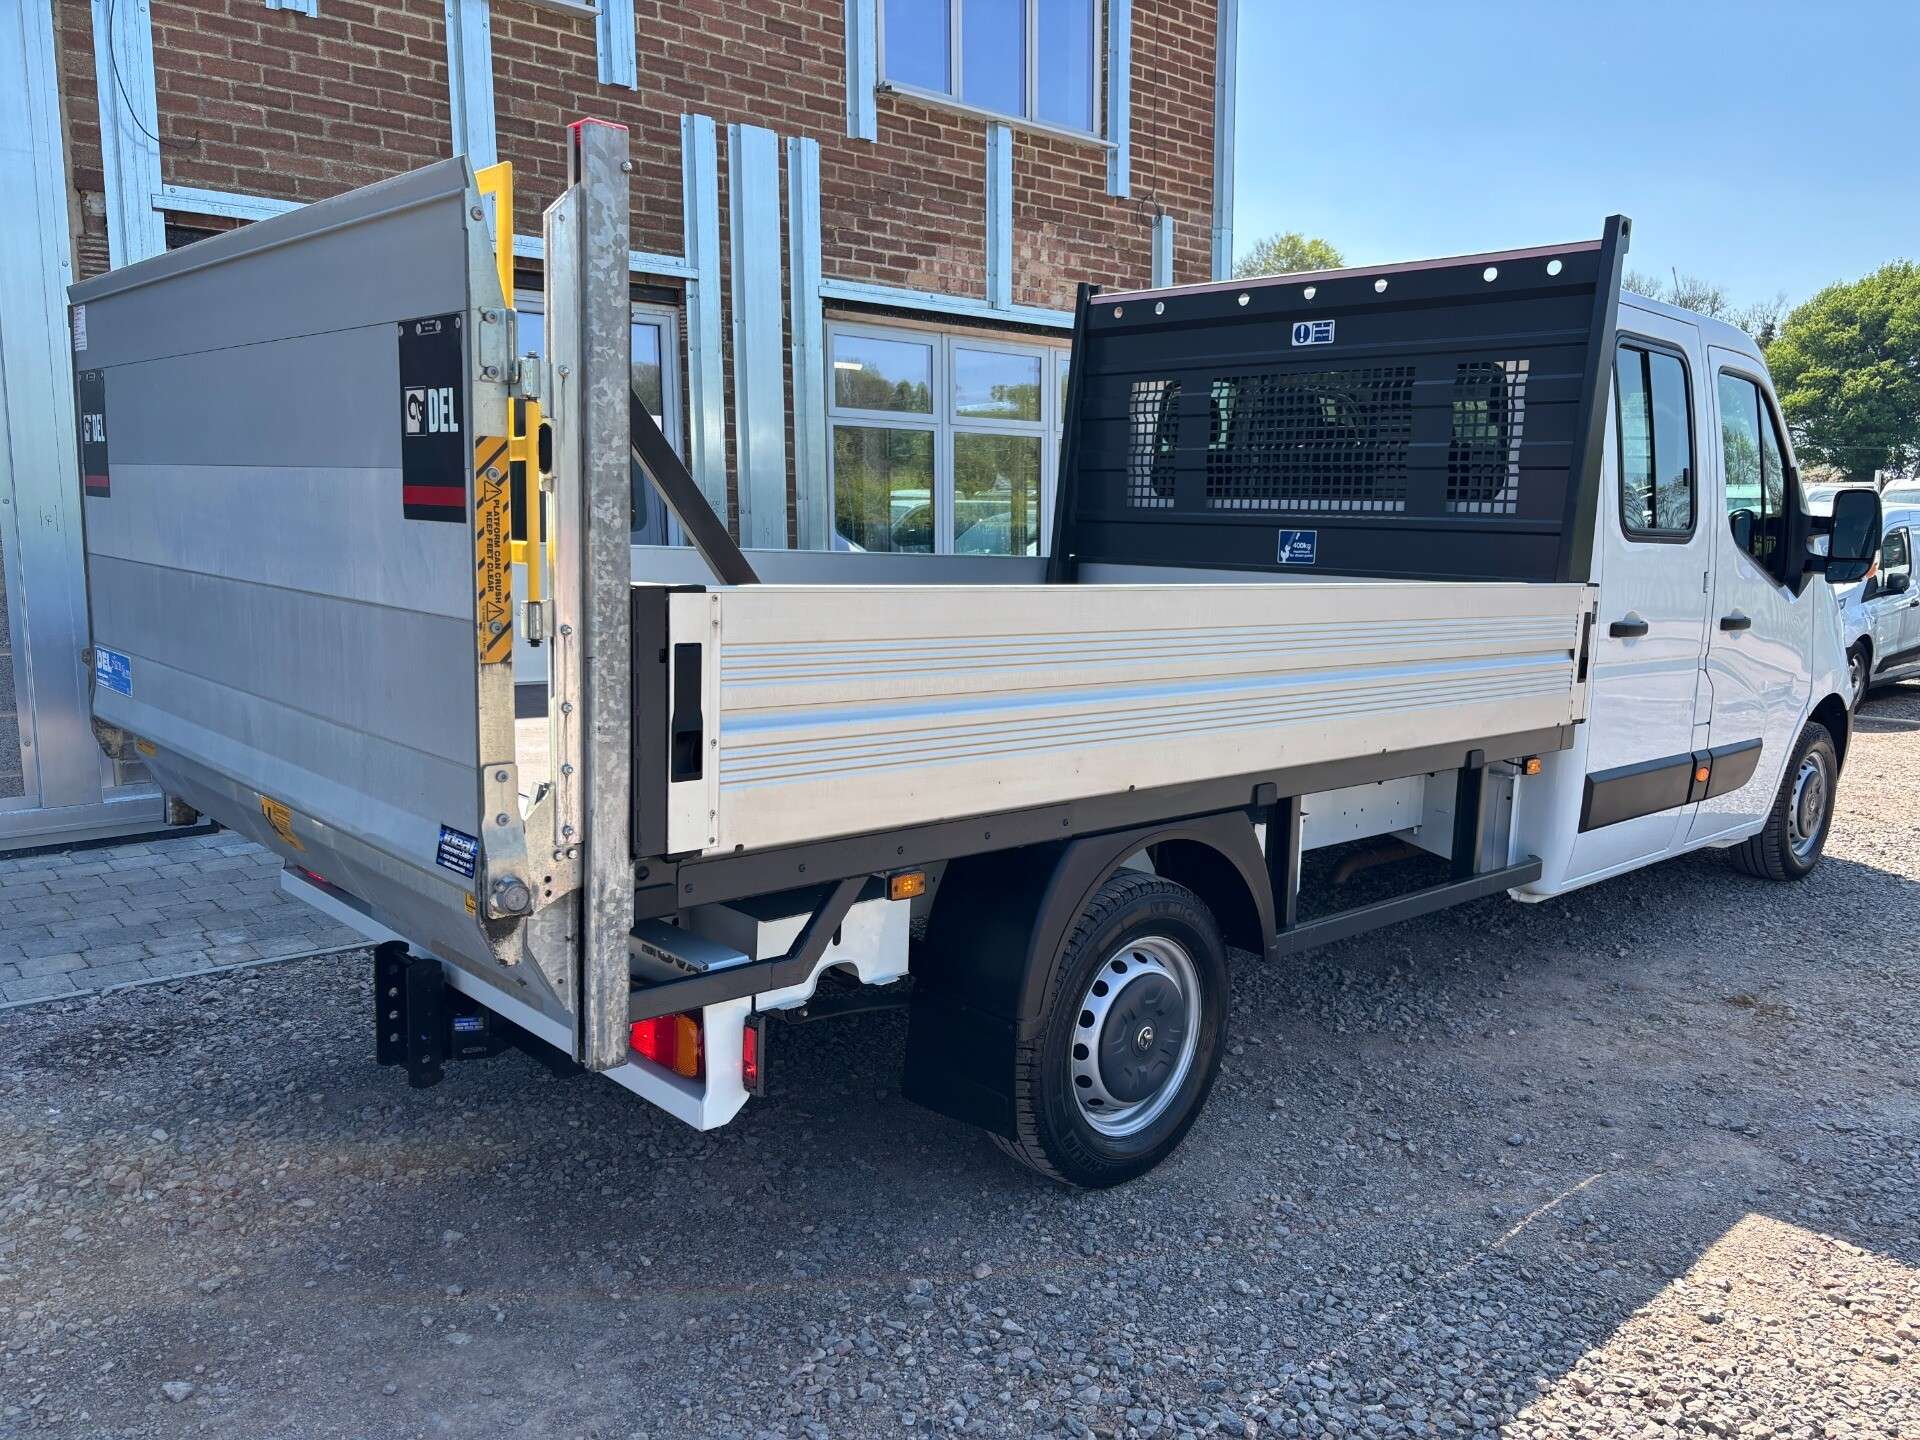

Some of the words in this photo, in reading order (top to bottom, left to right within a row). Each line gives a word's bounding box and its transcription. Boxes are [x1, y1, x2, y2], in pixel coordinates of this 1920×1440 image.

[428, 387, 459, 432] DEL
[92, 414, 105, 442] DEL
[493, 499, 501, 551] PLATFORM
[486, 539, 494, 560] FEET
[1293, 542, 1311, 550] 400kg
[494, 551, 502, 572] CAN
